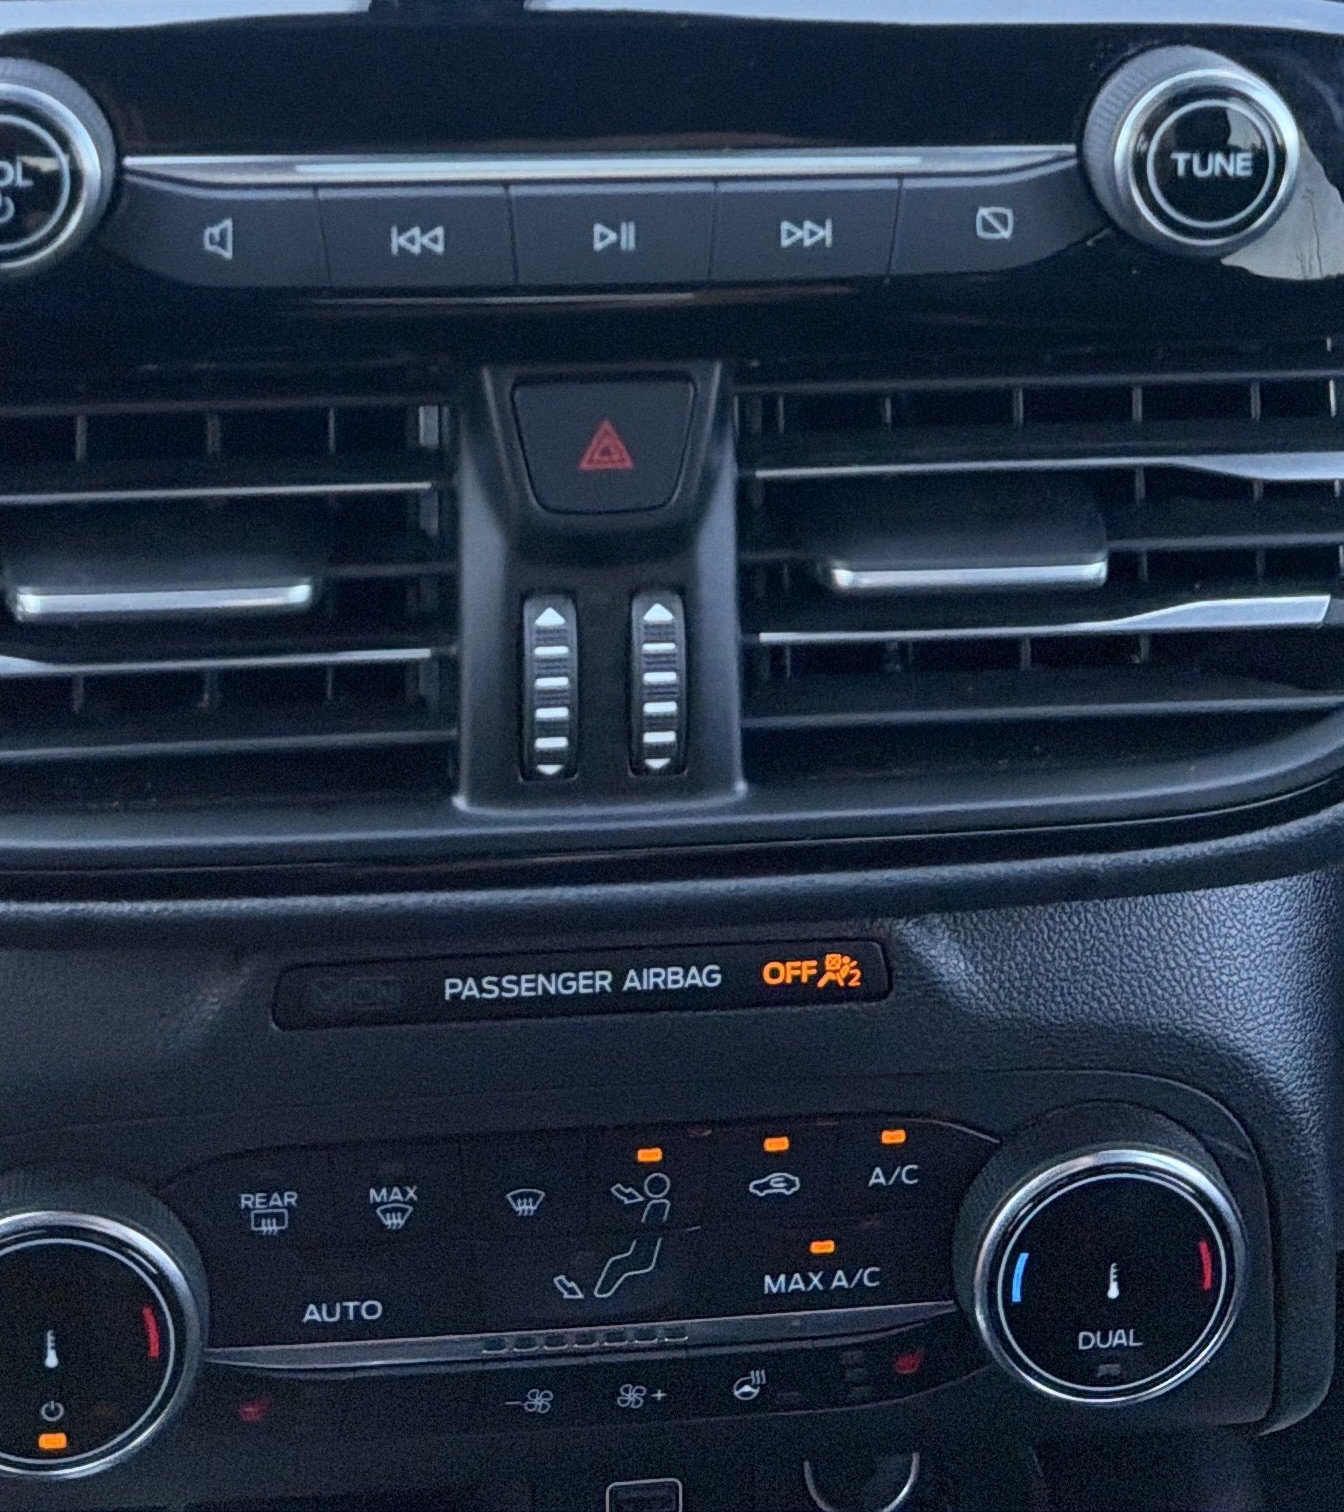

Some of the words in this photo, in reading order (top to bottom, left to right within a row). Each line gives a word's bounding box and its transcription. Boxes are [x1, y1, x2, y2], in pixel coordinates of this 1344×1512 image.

[1170, 151, 1253, 179] TUNE
[444, 970, 613, 1001] PASSENGER
[622, 964, 722, 991] AIRBAG
[762, 960, 818, 986] OFF
[867, 1164, 919, 1188] A/C
[240, 1191, 298, 1209] REAR
[369, 1185, 418, 1204] MAX
[763, 1271, 824, 1295] MAX
[830, 1267, 881, 1290] A/C
[302, 1300, 383, 1323] AUTO
[1078, 1328, 1144, 1350] DUAL
